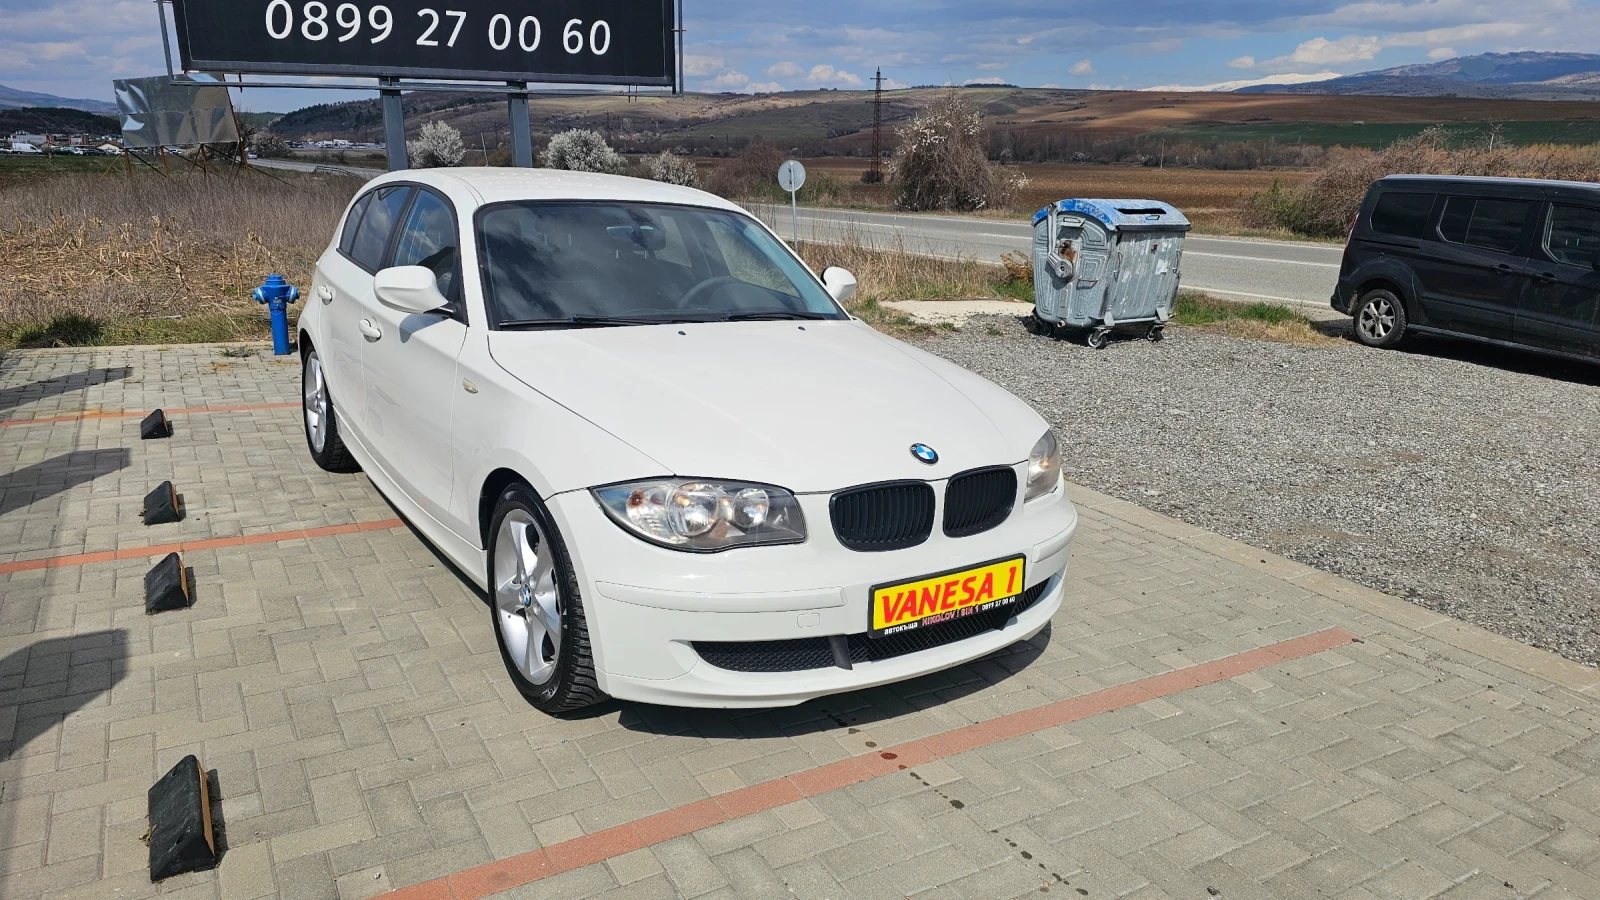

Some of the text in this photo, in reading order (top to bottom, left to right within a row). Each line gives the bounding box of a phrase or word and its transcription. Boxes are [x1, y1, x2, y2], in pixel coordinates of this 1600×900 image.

[265, 0, 611, 55] 0899 27 00 60
[882, 572, 994, 624] VANESA
[922, 610, 955, 626] NIKOLOV
[982, 602, 994, 611] 0899
[995, 599, 1001, 607] 27
[1002, 597, 1008, 605] 00
